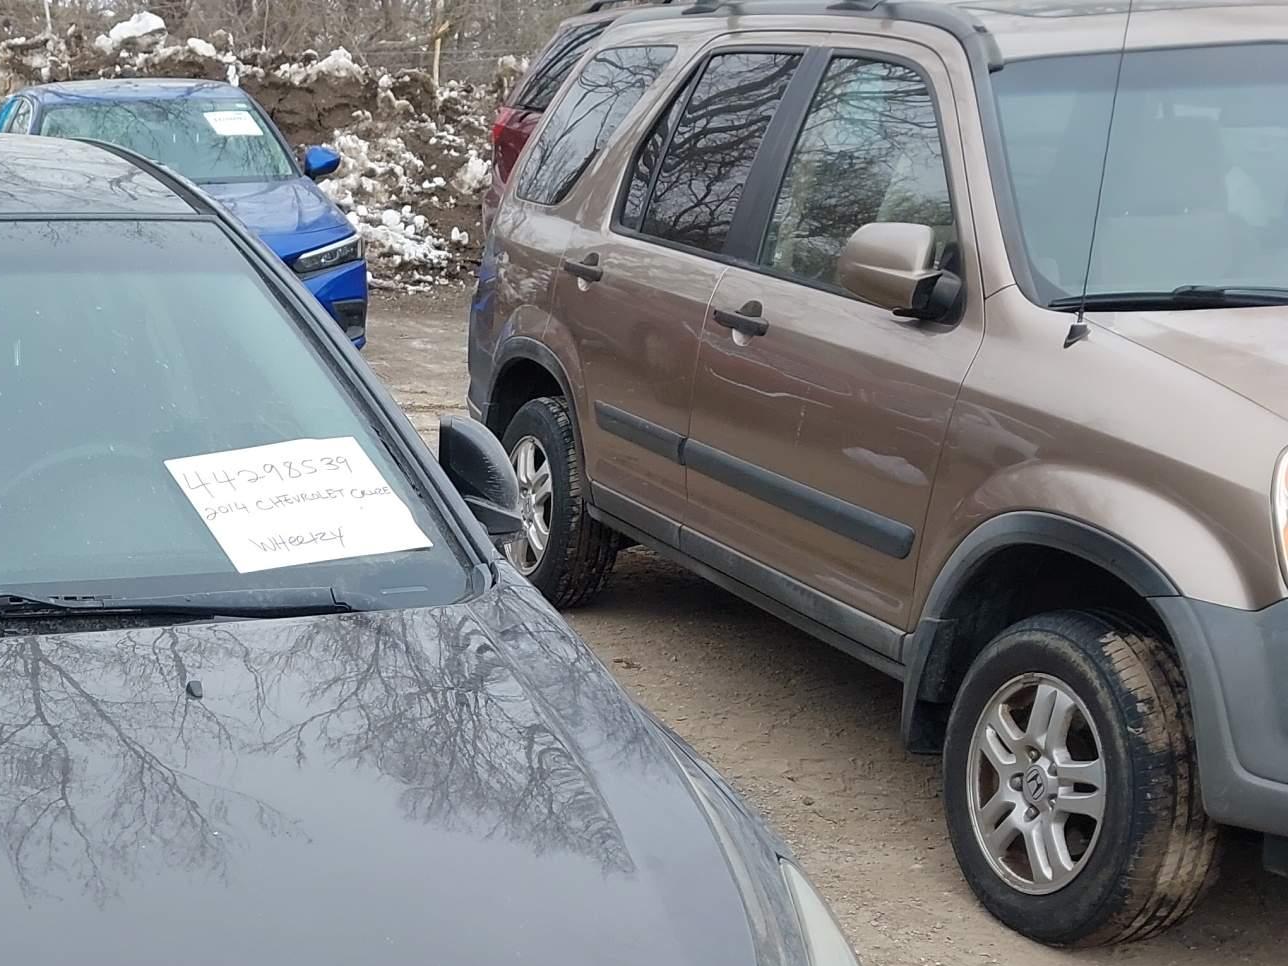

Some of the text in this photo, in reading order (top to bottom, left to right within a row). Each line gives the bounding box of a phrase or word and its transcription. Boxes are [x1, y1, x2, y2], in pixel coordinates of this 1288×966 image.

[182, 456, 353, 499] 44298539
[204, 502, 250, 521] 2014
[255, 488, 345, 511] CHEVROLET
